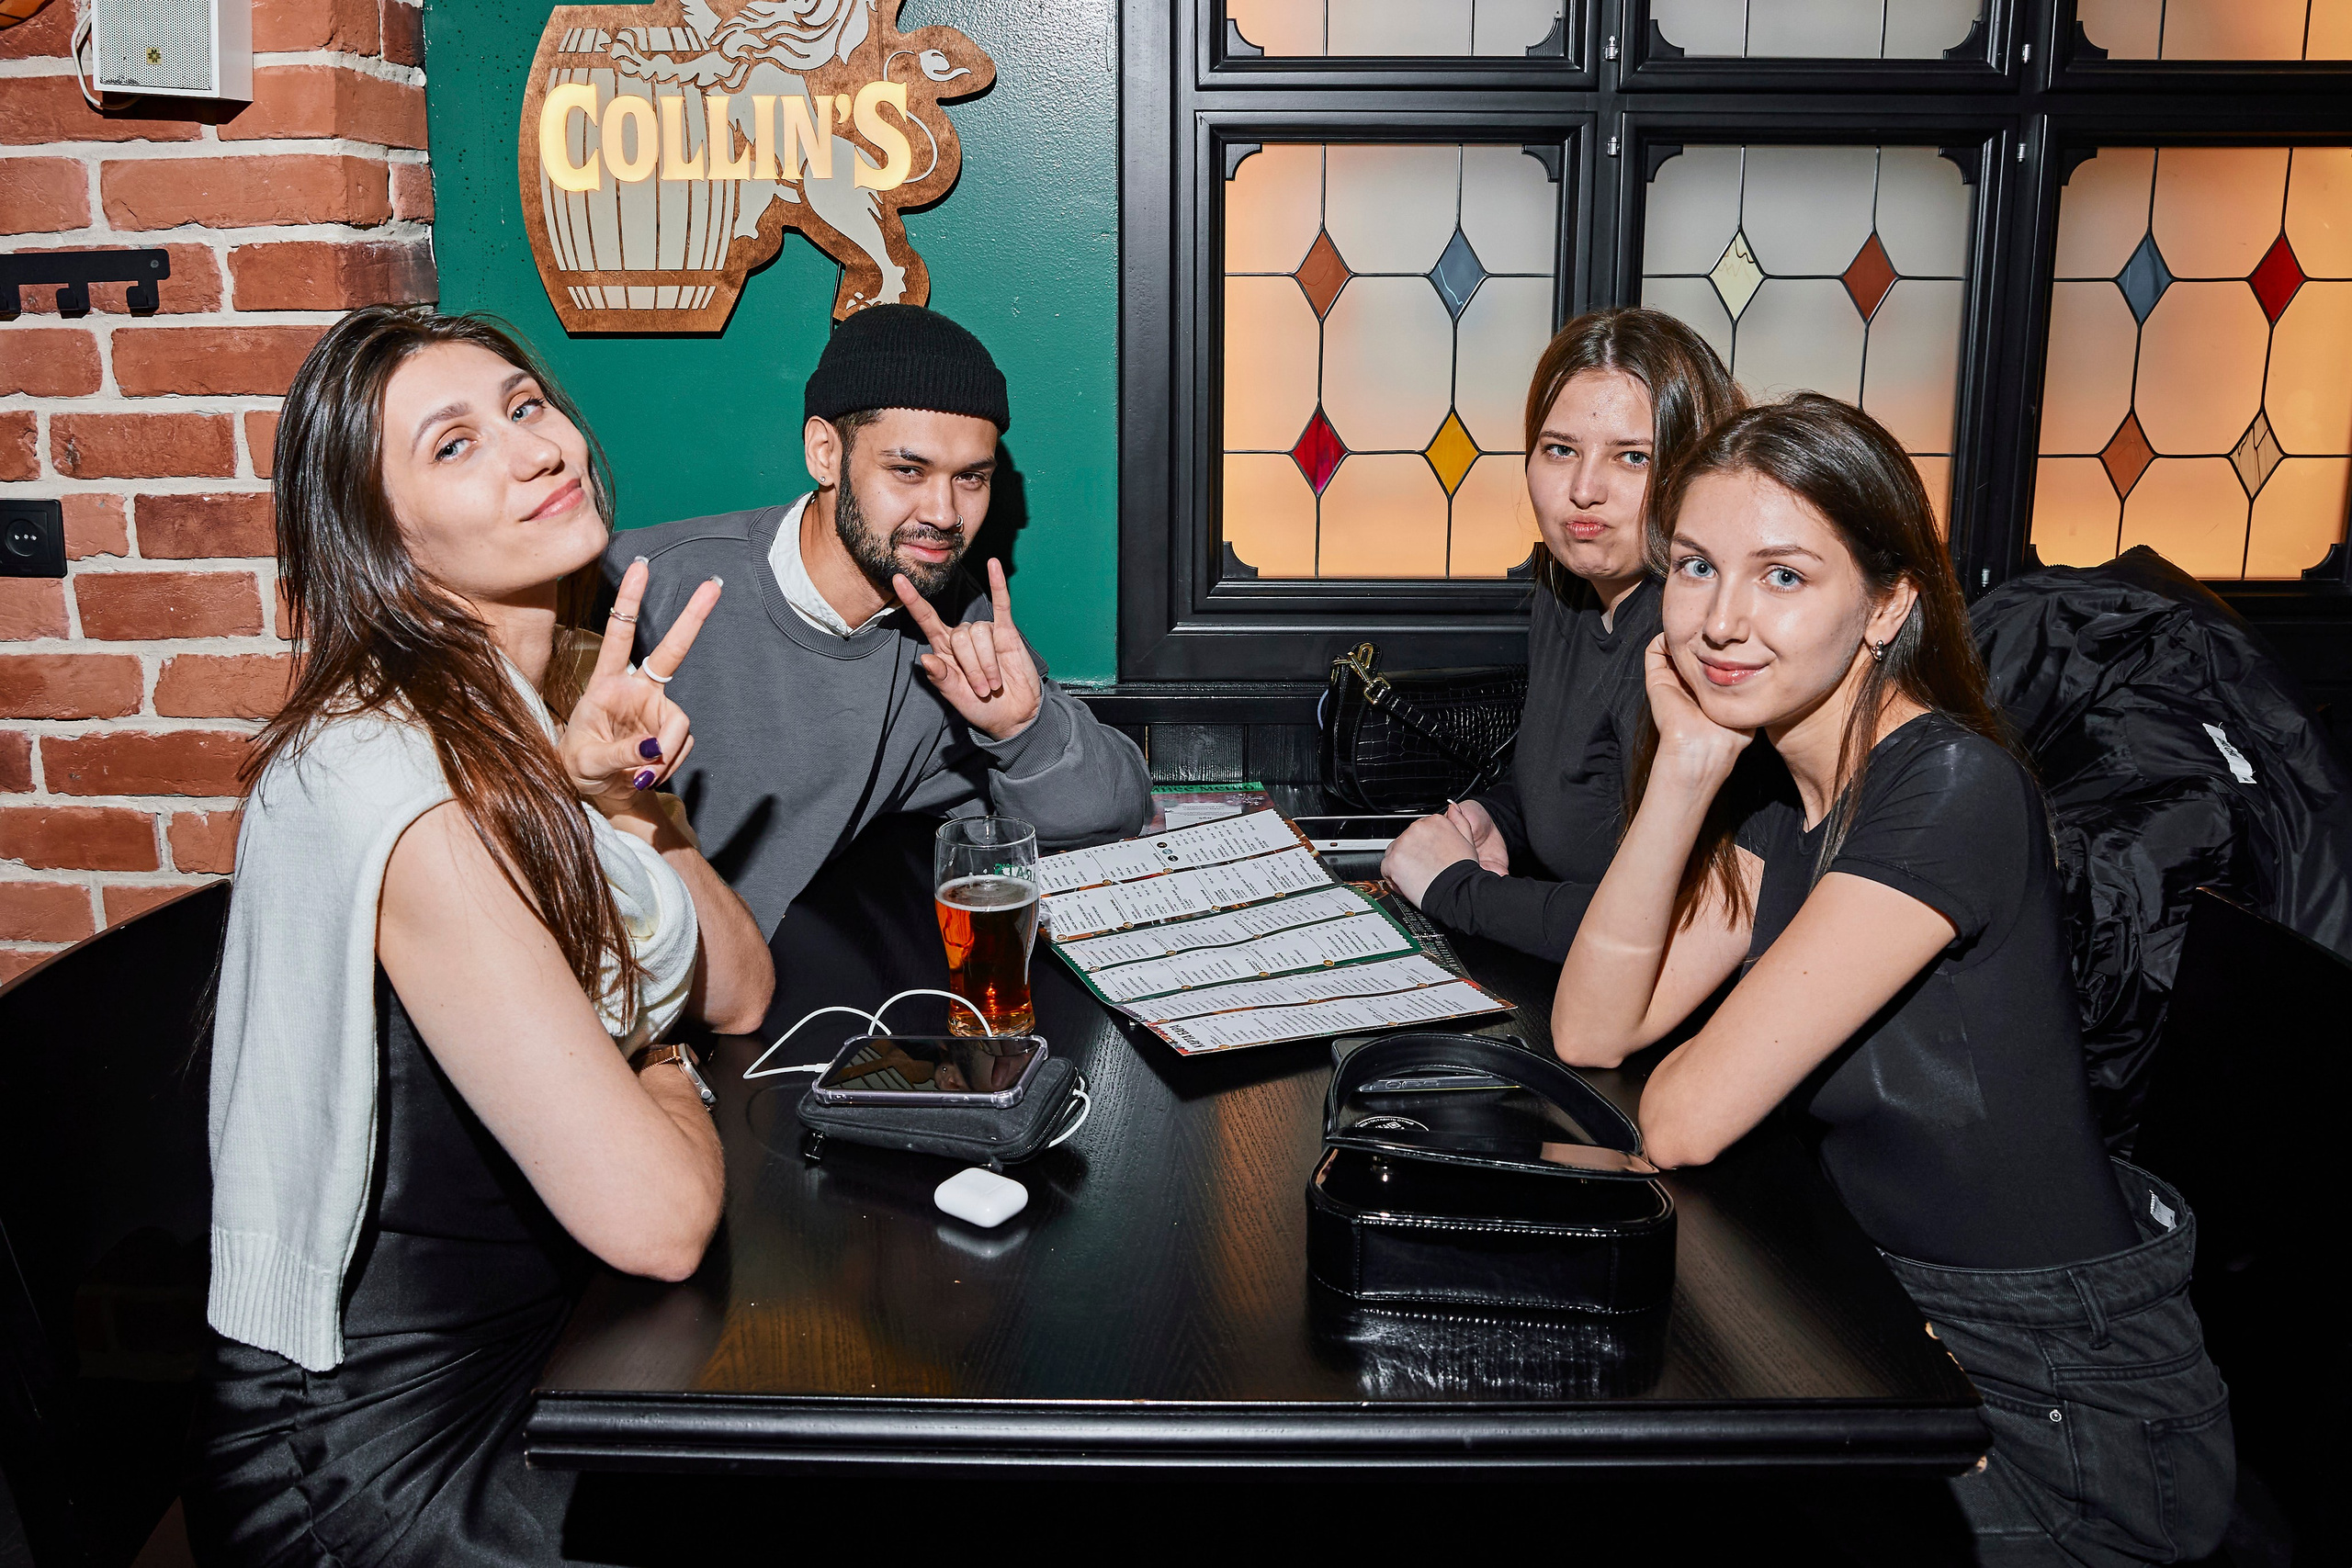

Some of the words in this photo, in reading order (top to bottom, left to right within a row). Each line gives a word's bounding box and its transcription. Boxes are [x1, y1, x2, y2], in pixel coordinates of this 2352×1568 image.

[539, 81, 912, 193] COLLIN'S
[1169, 1024, 1190, 1036] БАРА
[1179, 1033, 1205, 1048] КАРТА
